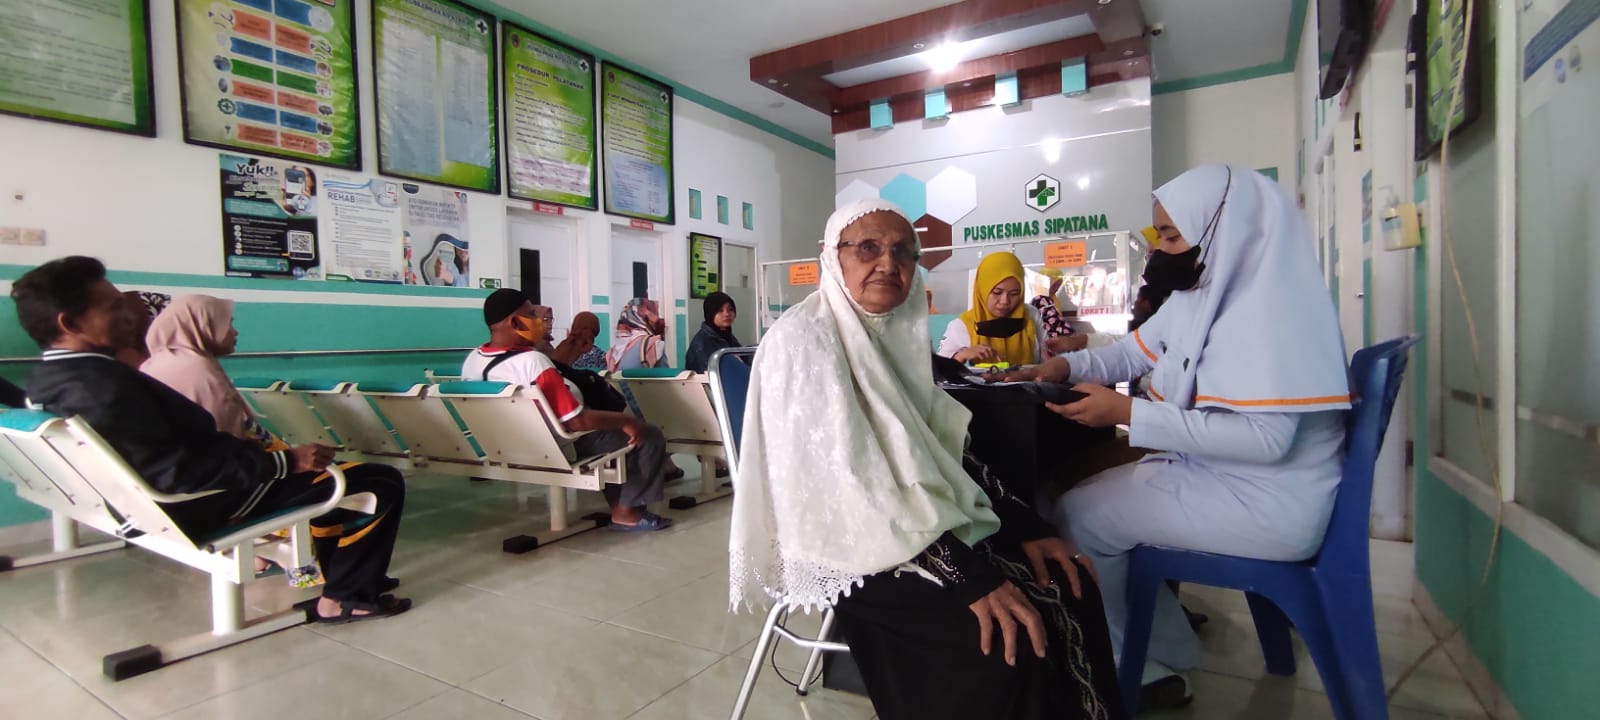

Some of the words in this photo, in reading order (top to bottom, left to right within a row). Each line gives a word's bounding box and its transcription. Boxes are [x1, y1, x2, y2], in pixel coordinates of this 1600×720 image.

[328, 192, 355, 203] REHAB
[964, 220, 1040, 242] PUSKESMAS
[1044, 213, 1109, 235] SIPATANA
[1080, 307, 1105, 315] LOKET
